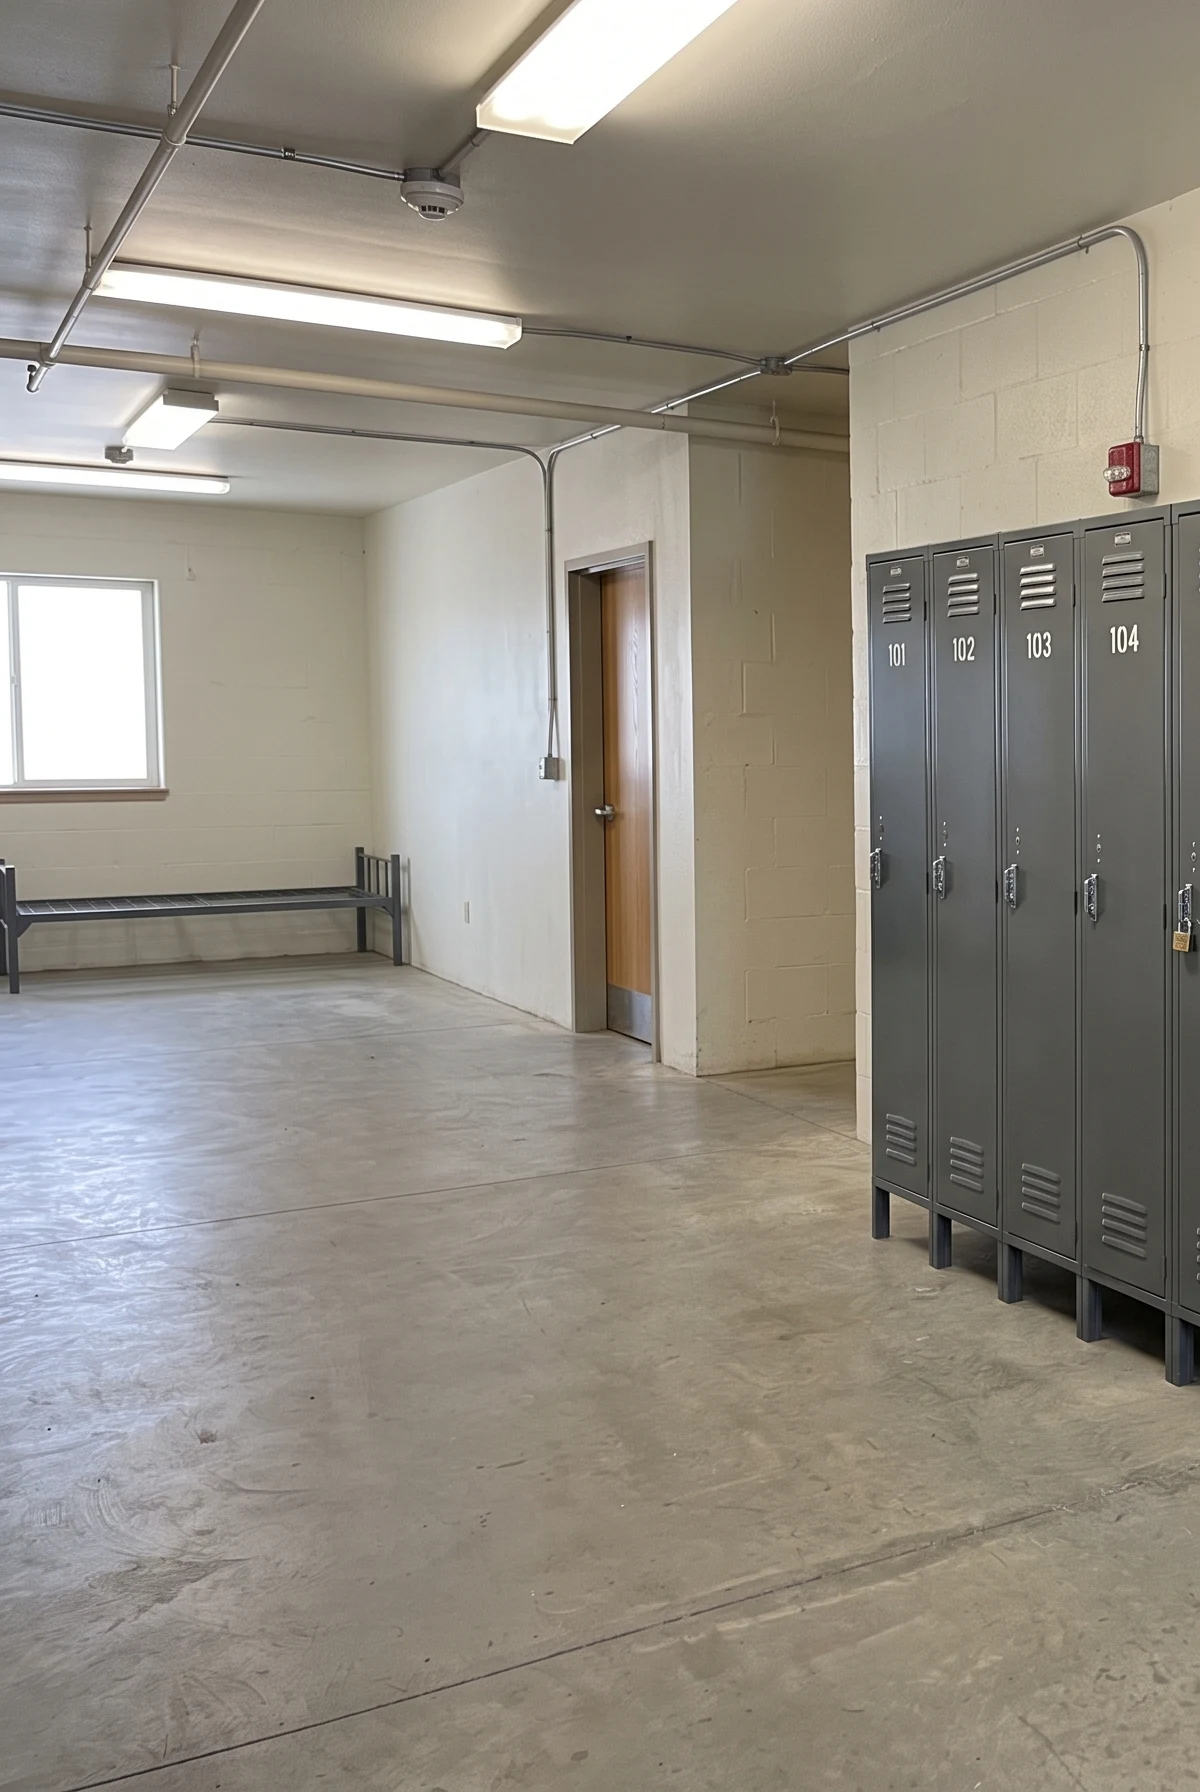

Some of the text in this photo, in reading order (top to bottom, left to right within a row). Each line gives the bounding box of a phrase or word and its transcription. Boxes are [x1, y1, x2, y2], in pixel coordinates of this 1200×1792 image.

[952, 636, 975, 662] 102
[1026, 631, 1052, 659] 103
[1109, 624, 1140, 654] 104
[888, 642, 906, 667] 101
